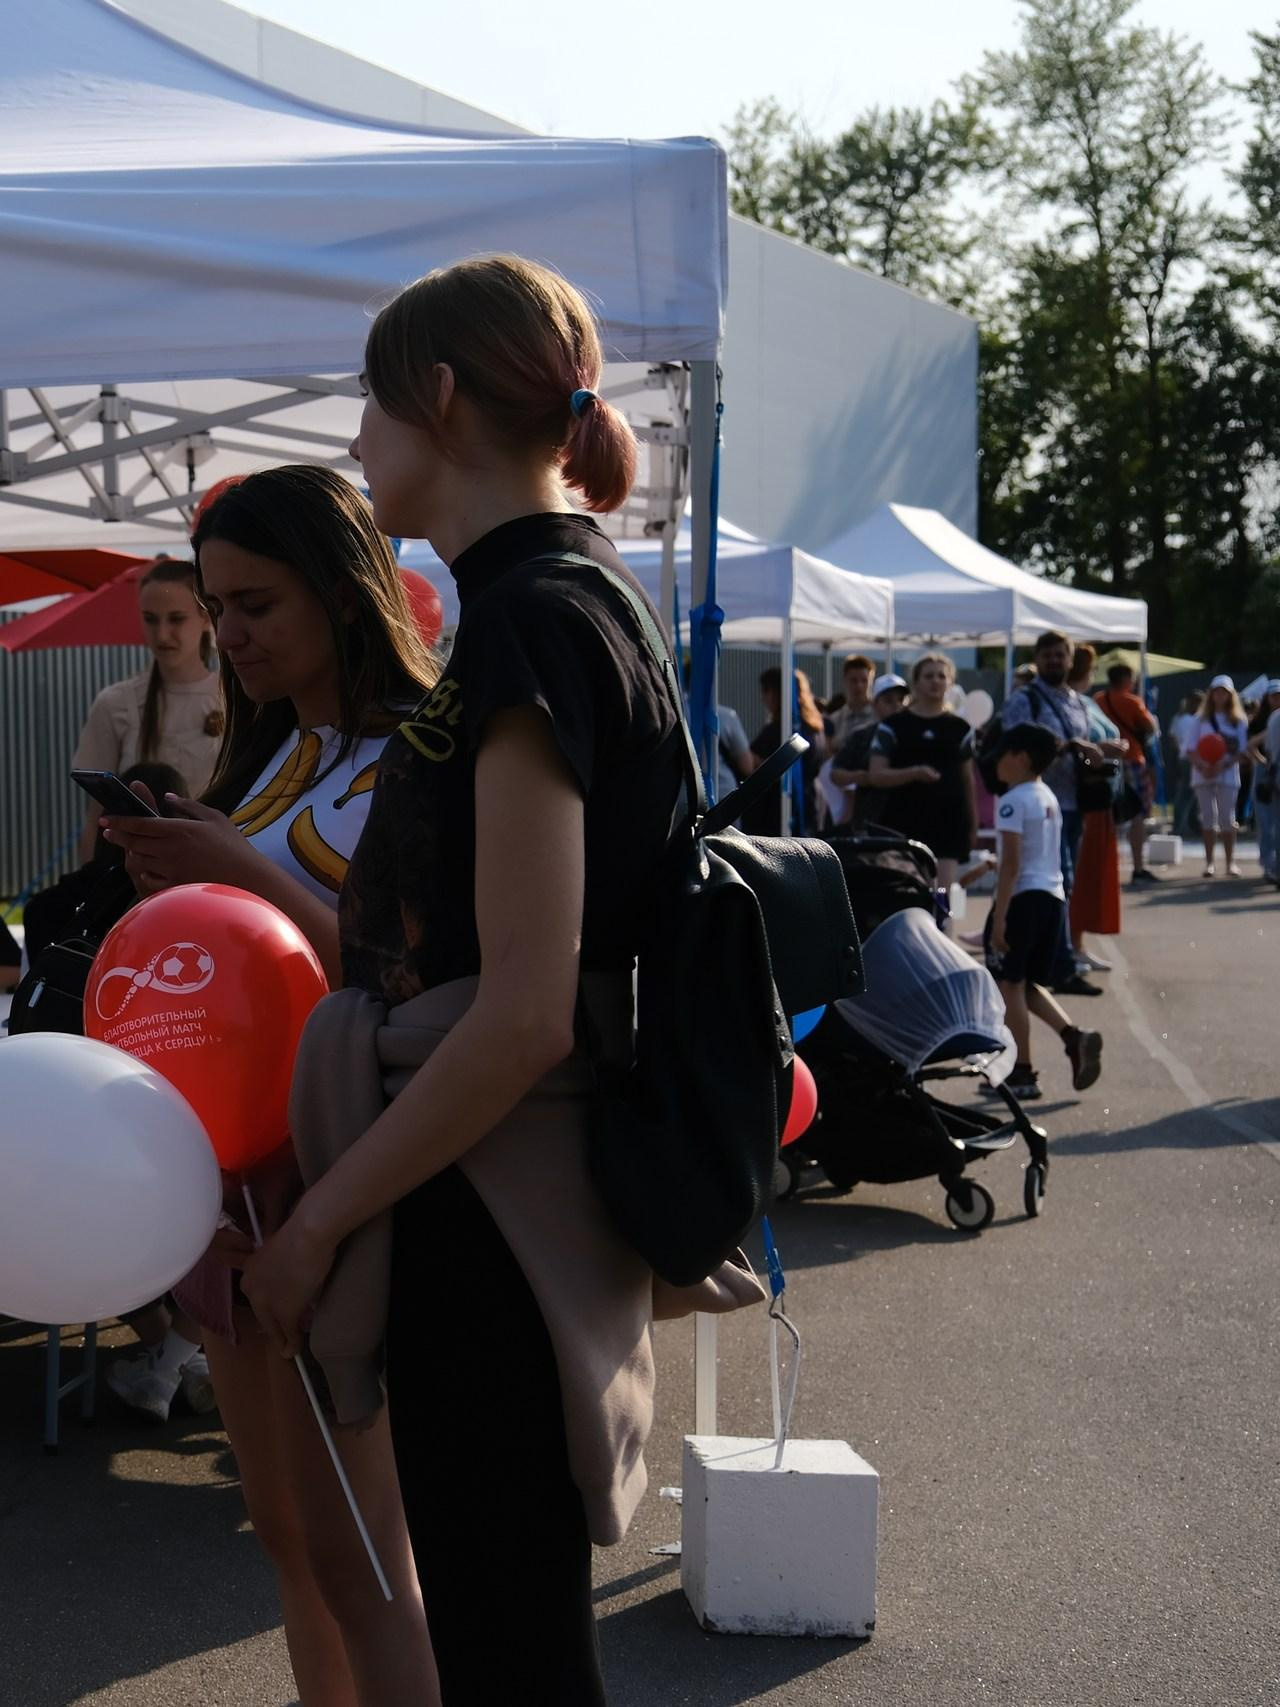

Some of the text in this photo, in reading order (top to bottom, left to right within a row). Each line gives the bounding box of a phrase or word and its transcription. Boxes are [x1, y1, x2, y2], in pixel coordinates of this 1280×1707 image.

[103, 1007, 207, 1042] БЛАГОТВОРИТЕЛЬНЫЙ
[112, 1022, 202, 1048] УТБОЛЬНЫЙ МАТЧ
[128, 1044, 154, 1057] РДЦА
[155, 1042, 164, 1052] К
[164, 1035, 206, 1050] СЕРДЦУ
